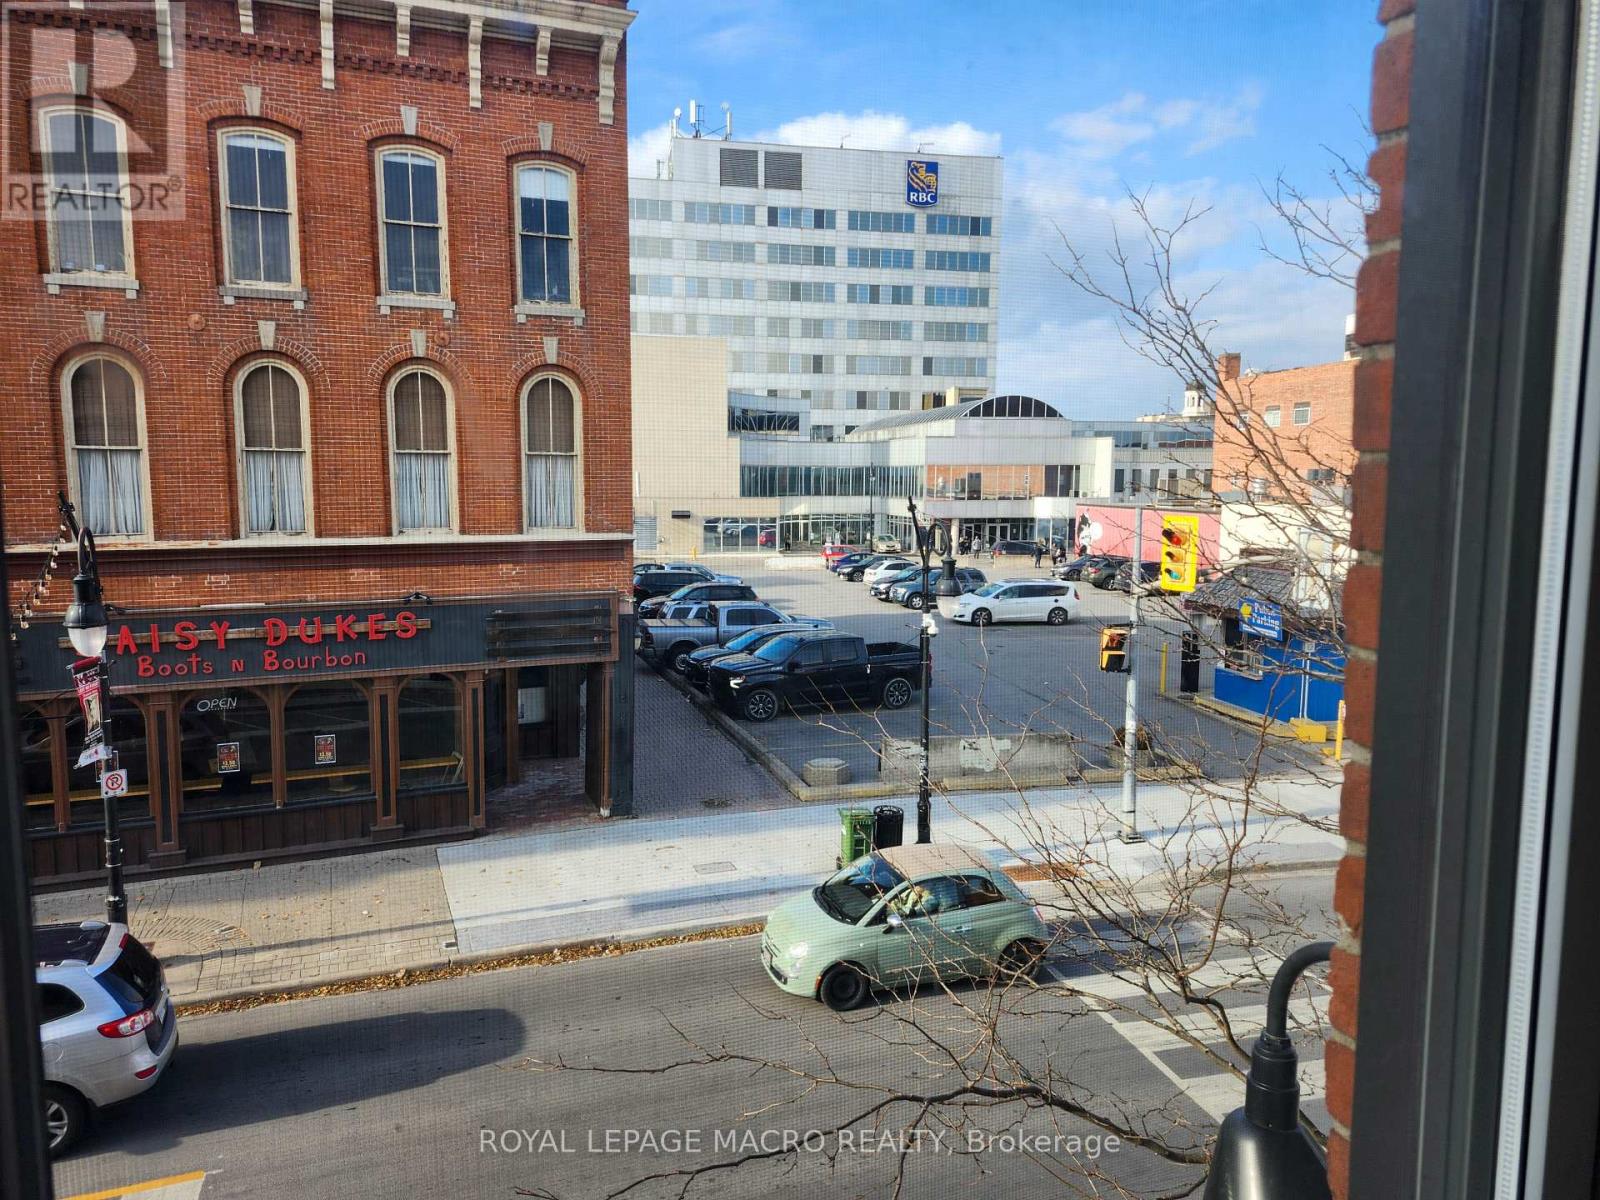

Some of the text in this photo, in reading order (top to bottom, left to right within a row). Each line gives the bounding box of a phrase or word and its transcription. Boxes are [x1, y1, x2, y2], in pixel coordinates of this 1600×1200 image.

[910, 192, 936, 203] RBC
[76, 611, 417, 657] AISY DUKES
[137, 652, 213, 678] Boots
[263, 646, 367, 672] Bourbon
[197, 697, 237, 711] OPEN
